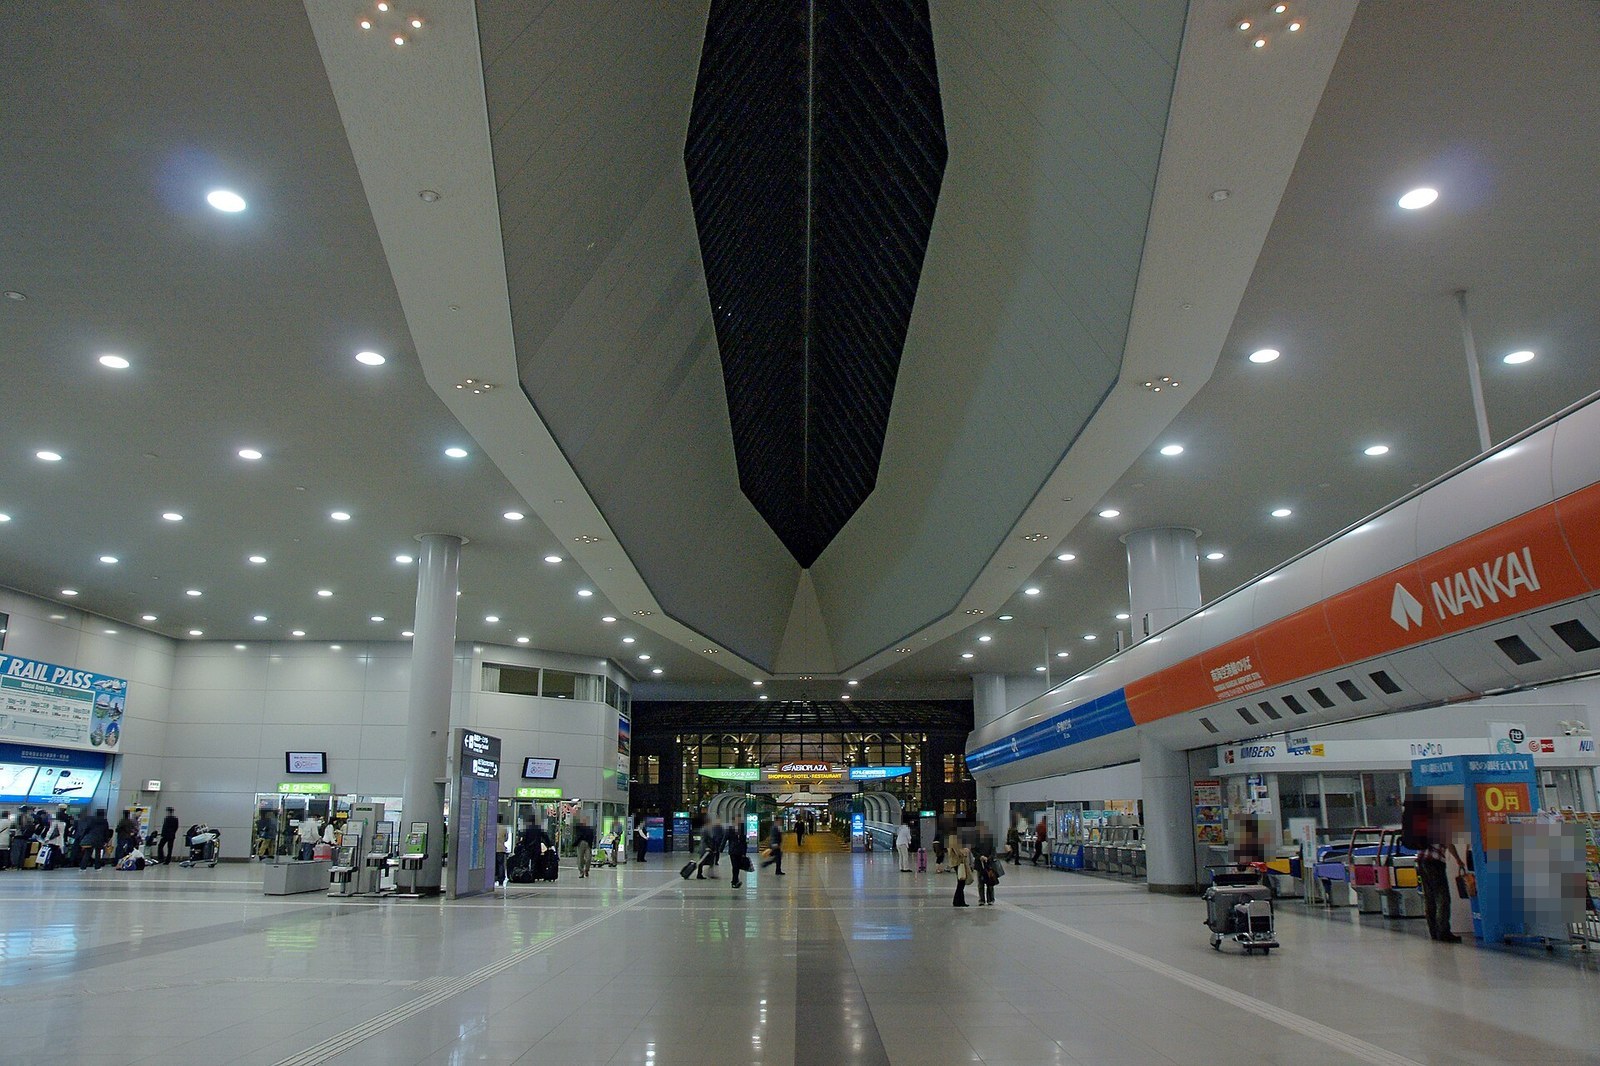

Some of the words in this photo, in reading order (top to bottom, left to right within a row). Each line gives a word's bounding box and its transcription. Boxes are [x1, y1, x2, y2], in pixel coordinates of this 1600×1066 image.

[1431, 546, 1541, 620] NANKAI
[7, 658, 49, 683] RAIL
[51, 667, 93, 689] PASS
[791, 764, 828, 772] AEROPLAZA
[1469, 759, 1529, 771] 駅の銀行ATM
